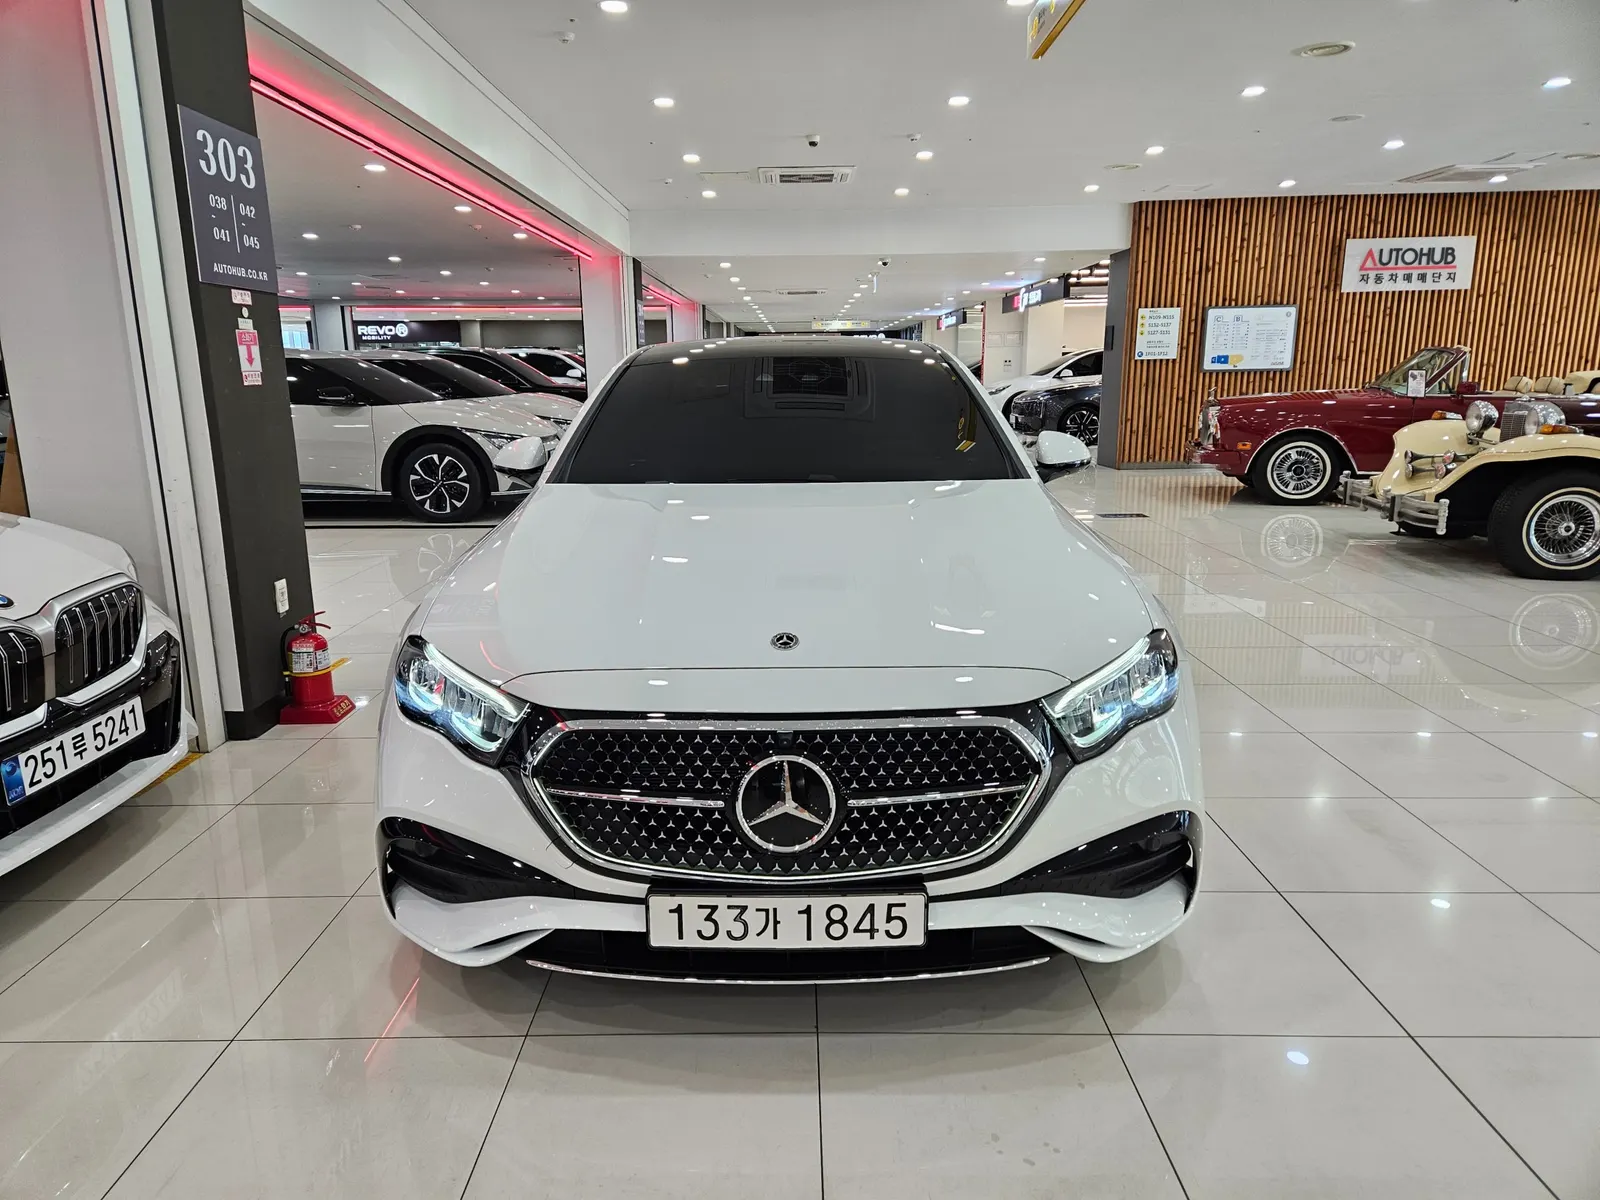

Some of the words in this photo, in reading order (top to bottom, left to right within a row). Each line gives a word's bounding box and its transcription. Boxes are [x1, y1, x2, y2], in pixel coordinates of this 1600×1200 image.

[196, 129, 256, 189] 303
[209, 193, 227, 211] 038
[239, 202, 256, 219] 042
[213, 226, 230, 242] 041
[243, 233, 260, 249] 045
[1359, 246, 1456, 269] AUTOHUB
[213, 262, 268, 281] AUTOHUB.CO.KR
[357, 325, 395, 335] REVO
[24, 732, 88, 788] 251루
[92, 704, 139, 752] 5241
[668, 902, 781, 942] 133가
[797, 902, 908, 942] 1845
